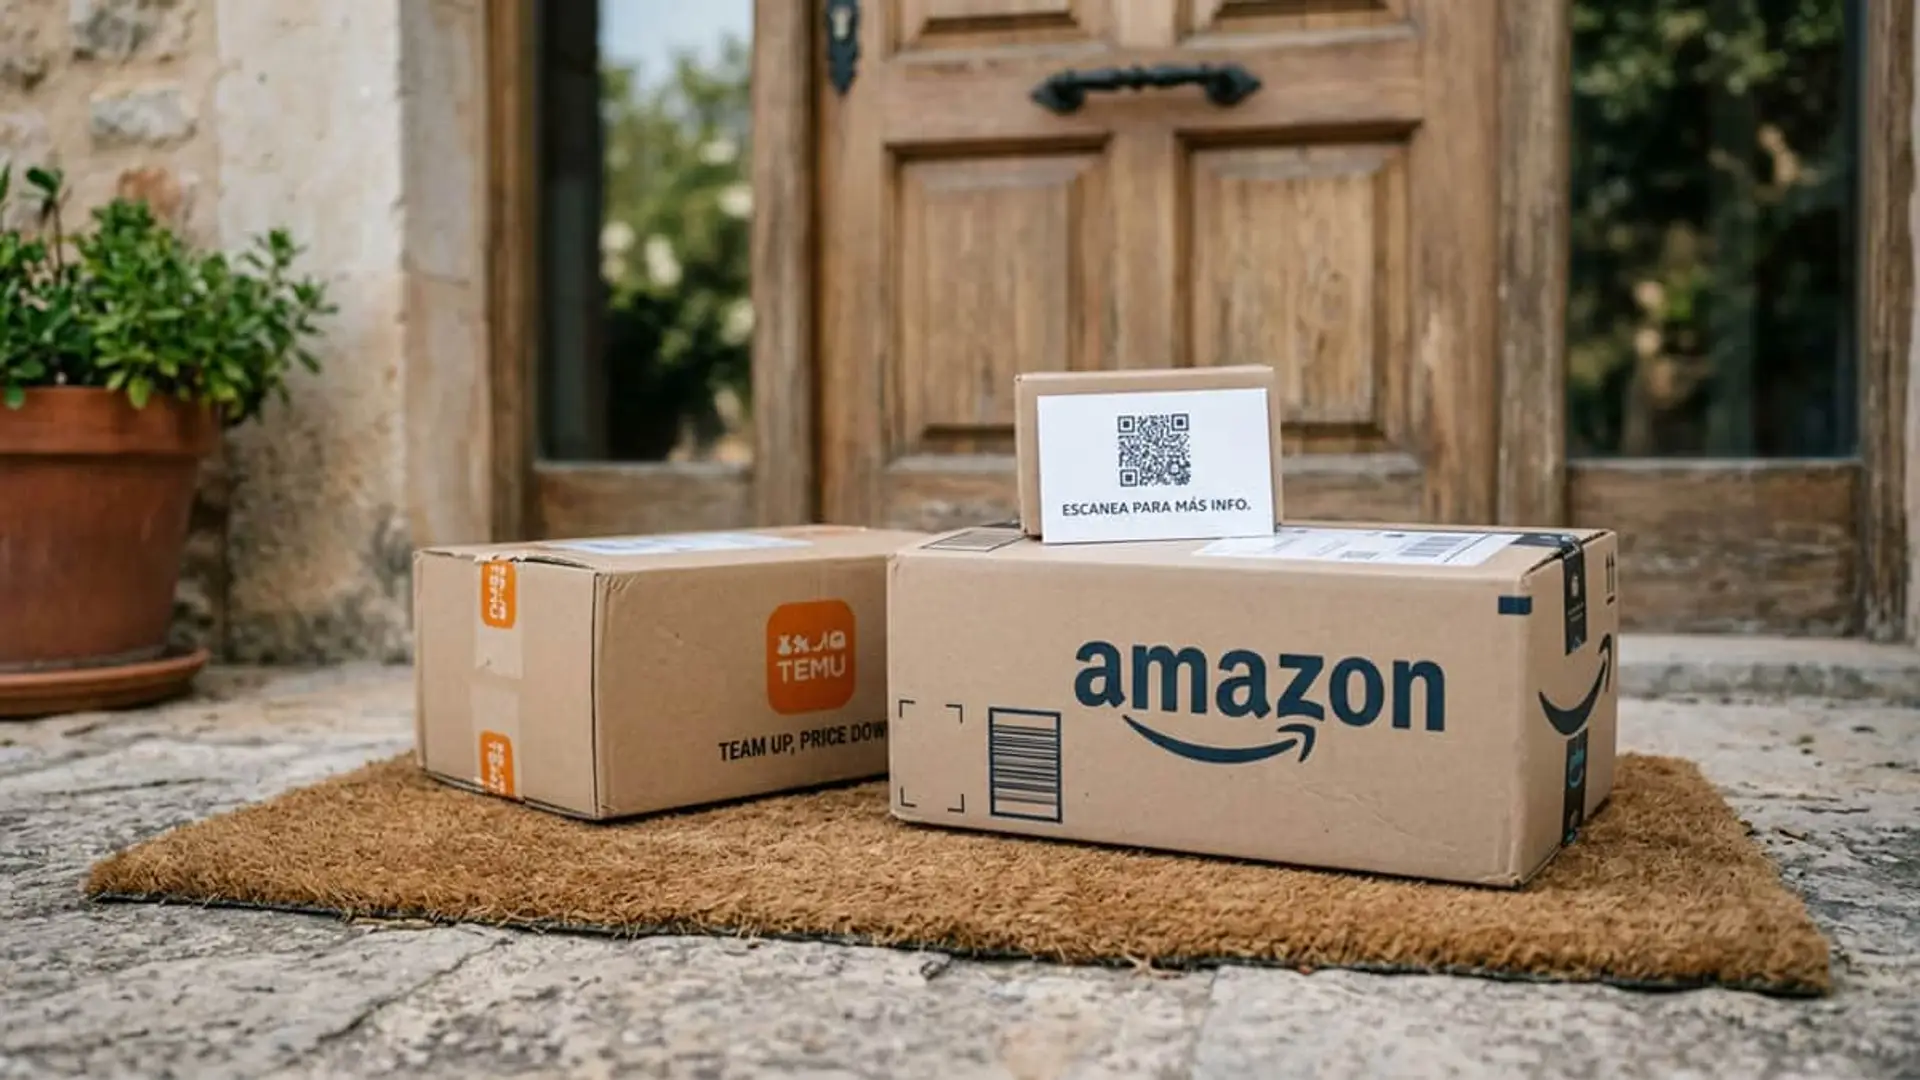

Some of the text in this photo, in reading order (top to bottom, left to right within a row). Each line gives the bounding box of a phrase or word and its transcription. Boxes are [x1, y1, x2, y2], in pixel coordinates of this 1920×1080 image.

[1062, 497, 1252, 517] ESCANEA PARA MÁS INFO.
[777, 654, 846, 683] TEMU
[1074, 640, 1445, 731] amazon
[718, 720, 888, 761] TEAM UP, PRICE DOW
